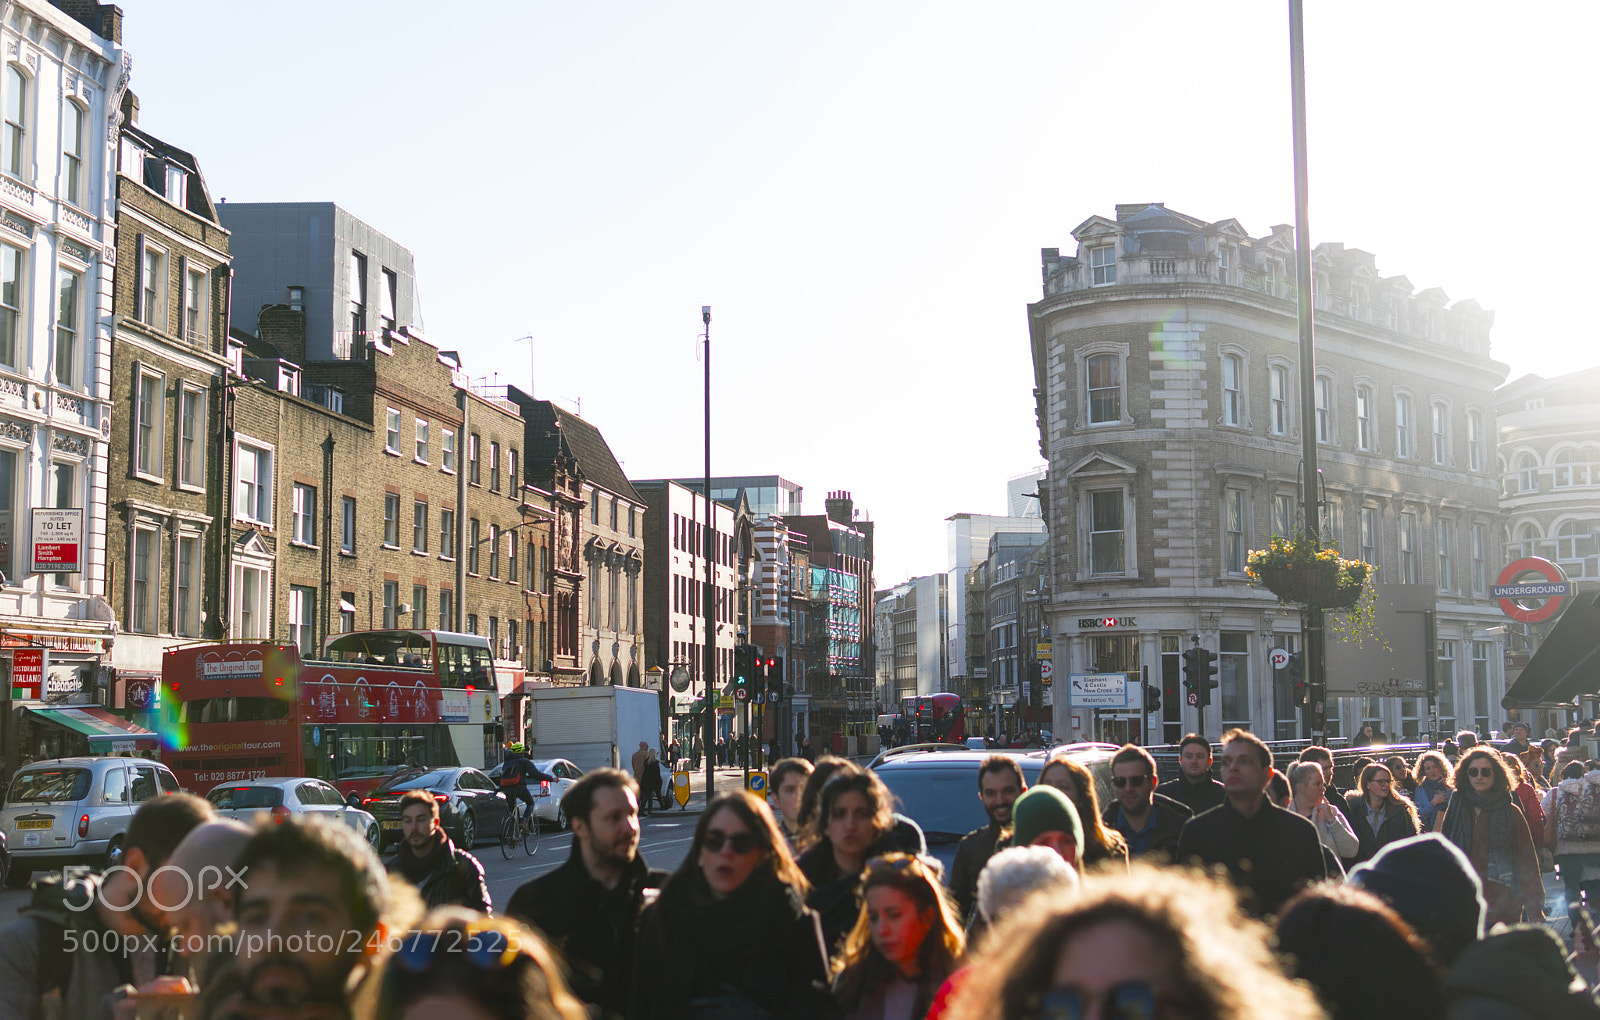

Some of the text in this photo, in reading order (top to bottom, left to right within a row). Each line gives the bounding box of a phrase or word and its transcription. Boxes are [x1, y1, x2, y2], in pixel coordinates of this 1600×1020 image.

[42, 522, 72, 530] TO LET
[1494, 585, 1565, 596] UNDERGROUND
[1078, 616, 1137, 628] HSBC UK
[13, 665, 42, 673] RISTORANTE
[206, 661, 260, 674] The Original Tour
[12, 674, 42, 683] ITALIANO
[178, 741, 281, 752] www.theoriginaltour.com
[194, 770, 266, 782] Tel: 020 8877 1722
